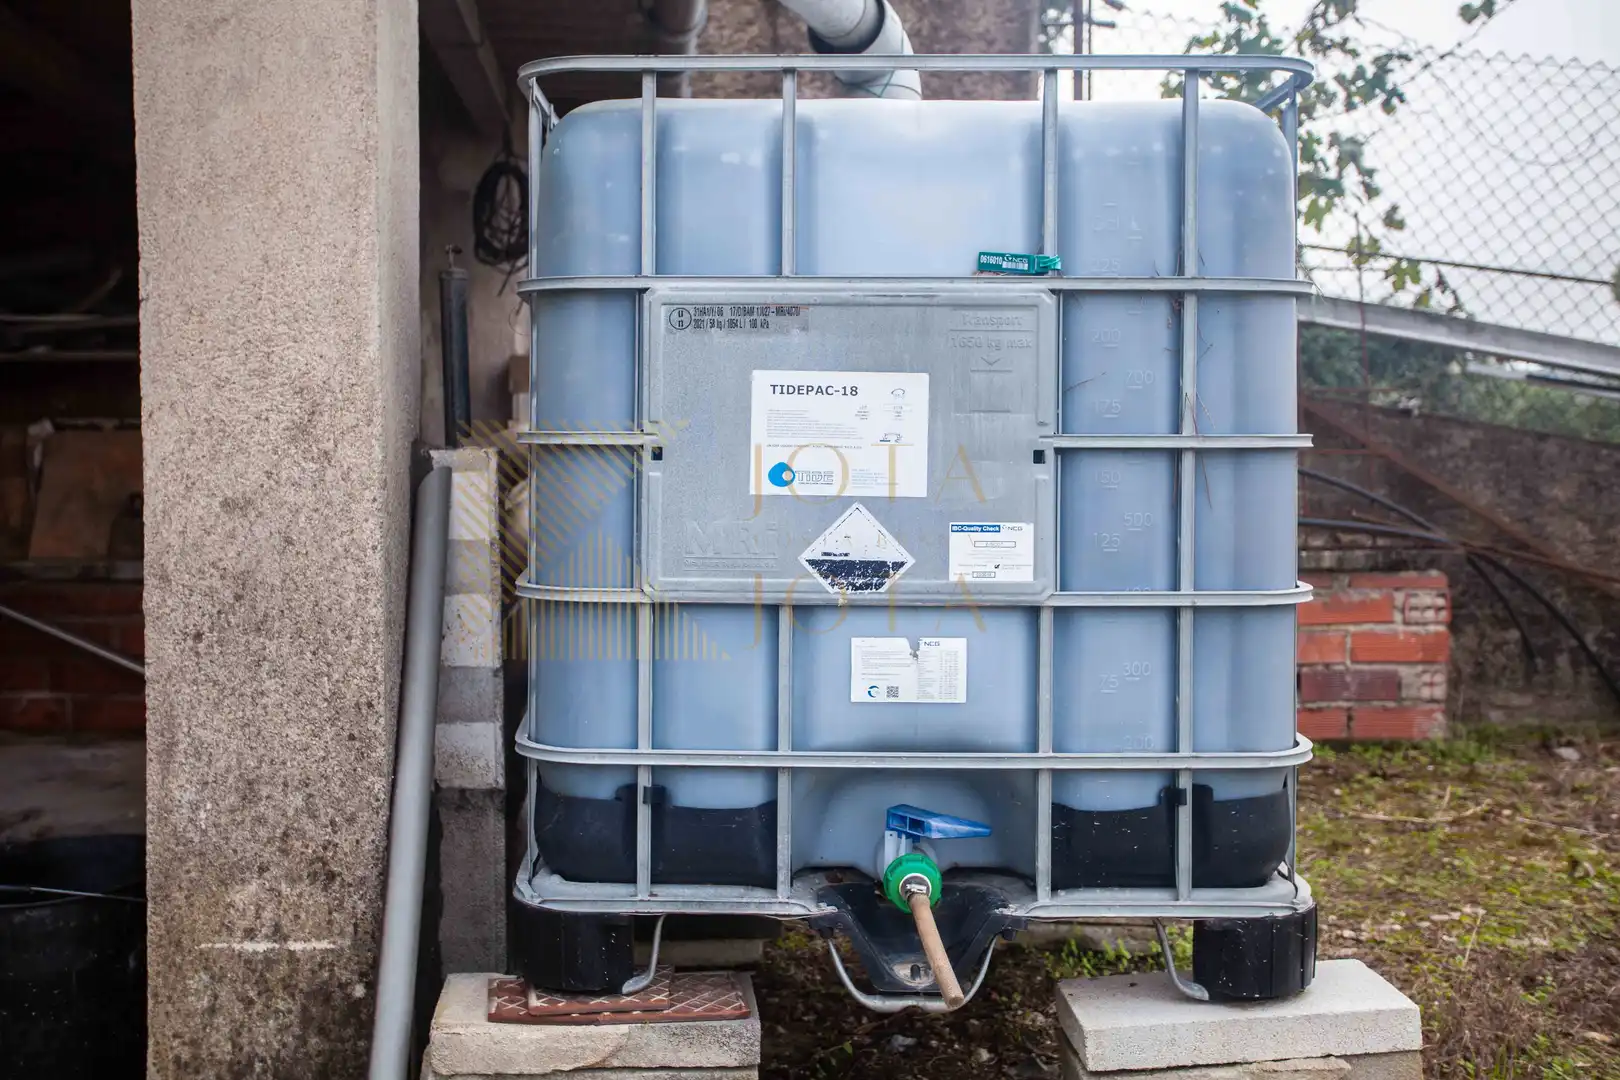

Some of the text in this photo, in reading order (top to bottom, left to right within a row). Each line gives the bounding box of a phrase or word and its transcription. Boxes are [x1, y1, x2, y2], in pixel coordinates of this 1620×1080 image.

[980, 255, 1003, 265] 0616010
[1125, 369, 1155, 385] 700
[770, 384, 859, 397] TIDEPAC-18
[1092, 398, 1121, 413] 175
[795, 470, 834, 483] TIDE
[1123, 511, 1153, 528] 500
[952, 525, 982, 533] IBC-Quality
[1093, 531, 1121, 548] 125
[1122, 660, 1152, 676] 300
[1099, 673, 1119, 689] 75
